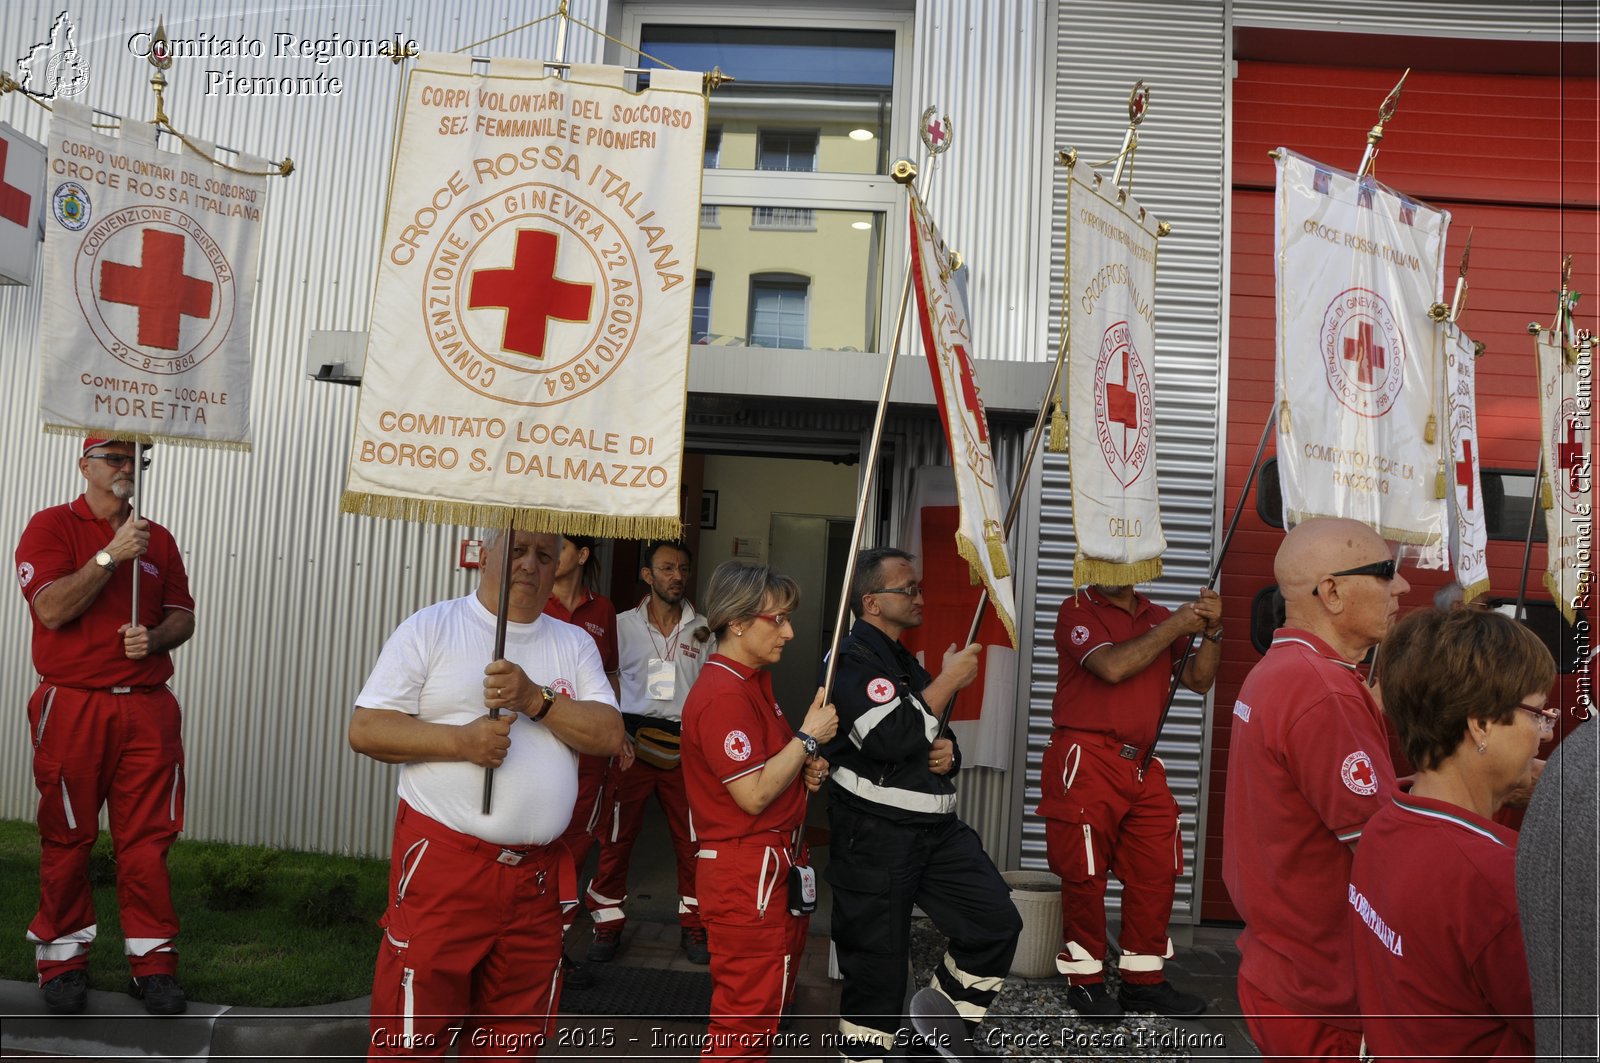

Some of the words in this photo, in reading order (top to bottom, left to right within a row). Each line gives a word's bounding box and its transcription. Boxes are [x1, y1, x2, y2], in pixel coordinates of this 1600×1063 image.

[475, 115, 567, 140] FEMMINILE
[569, 125, 581, 144] E
[586, 127, 657, 150] PIONIERI
[478, 88, 564, 112] VOLONTARI
[571, 99, 603, 120] DEL
[612, 104, 692, 130] SOCCORSO
[52, 158, 120, 190] CROCE
[127, 177, 190, 205] ROSSA
[194, 195, 260, 222] ITALIANA
[62, 140, 105, 164] CORPO
[109, 154, 175, 181] VOLONTARI
[181, 171, 201, 190] DEL
[204, 178, 257, 204] SOCCORSO
[390, 169, 470, 266] CROCE
[473, 145, 581, 185] ROSSA
[587, 164, 685, 292] ITALIANA
[469, 207, 495, 233] DI
[504, 190, 605, 242] GINEVRA
[83, 208, 172, 257] CONVENZIONE
[178, 215, 191, 229] DI
[192, 227, 231, 284] GINEVRA
[600, 242, 628, 271] 22
[1303, 219, 1340, 245] CROCE
[1344, 232, 1380, 259] ROSSA
[1382, 246, 1421, 272] ITALIANA
[429, 232, 496, 388] CONVENZIONE
[594, 278, 634, 363] AGOSTO
[1335, 304, 1346, 318] DI
[1346, 296, 1384, 319] GINEVRA
[544, 358, 601, 397] 1864
[1326, 316, 1358, 403] CONVENZIONE
[1388, 337, 1401, 392] AGOSTO
[80, 373, 158, 396] COMITATO
[174, 387, 228, 405] LOCALE
[94, 394, 207, 425] MORETTA
[1105, 337, 1114, 352] DI
[1129, 351, 1140, 368] 22
[1136, 371, 1150, 438] AGOSTO
[379, 410, 506, 439] COMITATO
[516, 420, 620, 454] LOCALE
[629, 435, 654, 456] DI
[1304, 443, 1364, 467] COMITATO
[359, 439, 459, 470] BORGO
[468, 447, 493, 473] S.
[505, 451, 668, 489] DALMAZZO
